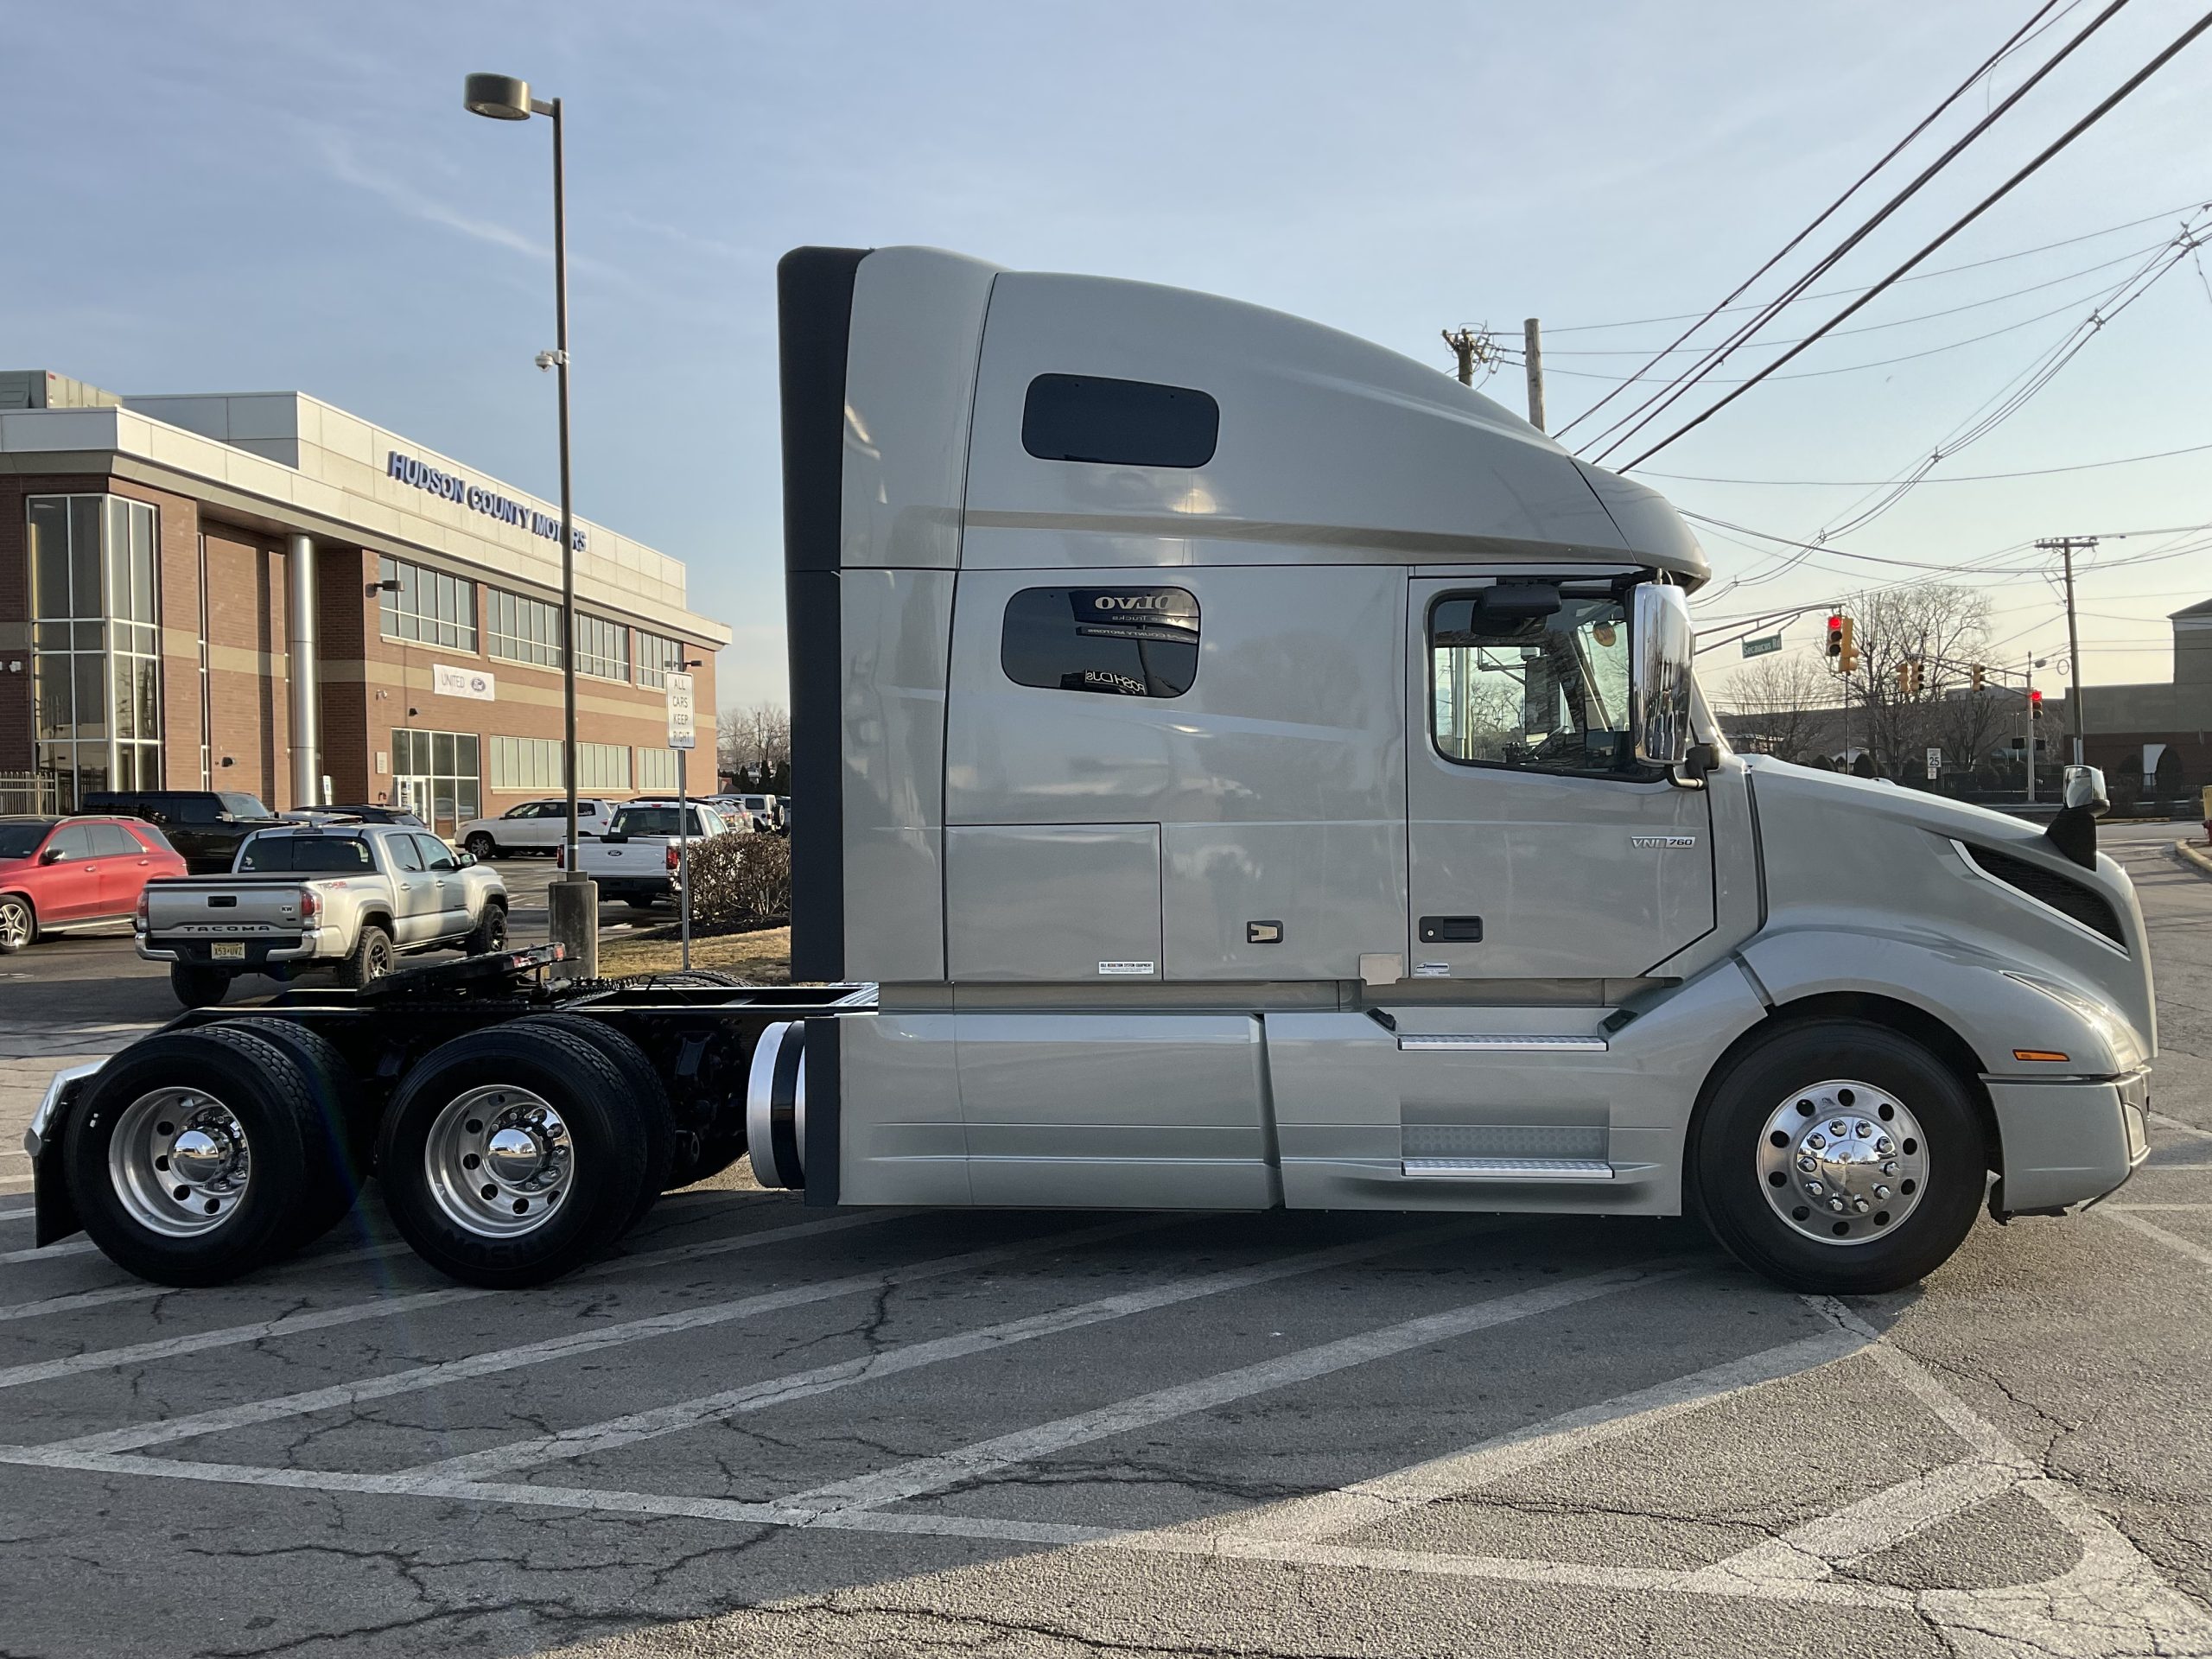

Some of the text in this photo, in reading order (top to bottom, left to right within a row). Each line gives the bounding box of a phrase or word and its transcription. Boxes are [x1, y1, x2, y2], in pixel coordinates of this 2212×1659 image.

[388, 451, 587, 551] HUDSON COUNTY MOTRS
[1743, 638, 1780, 656] Secaucus Rd
[442, 672, 465, 689] UNITED
[674, 678, 686, 690] ALL
[673, 696, 689, 709] CARS
[673, 714, 689, 726] KEEP
[673, 731, 690, 743] RIGHT
[1929, 756, 1939, 766] 25
